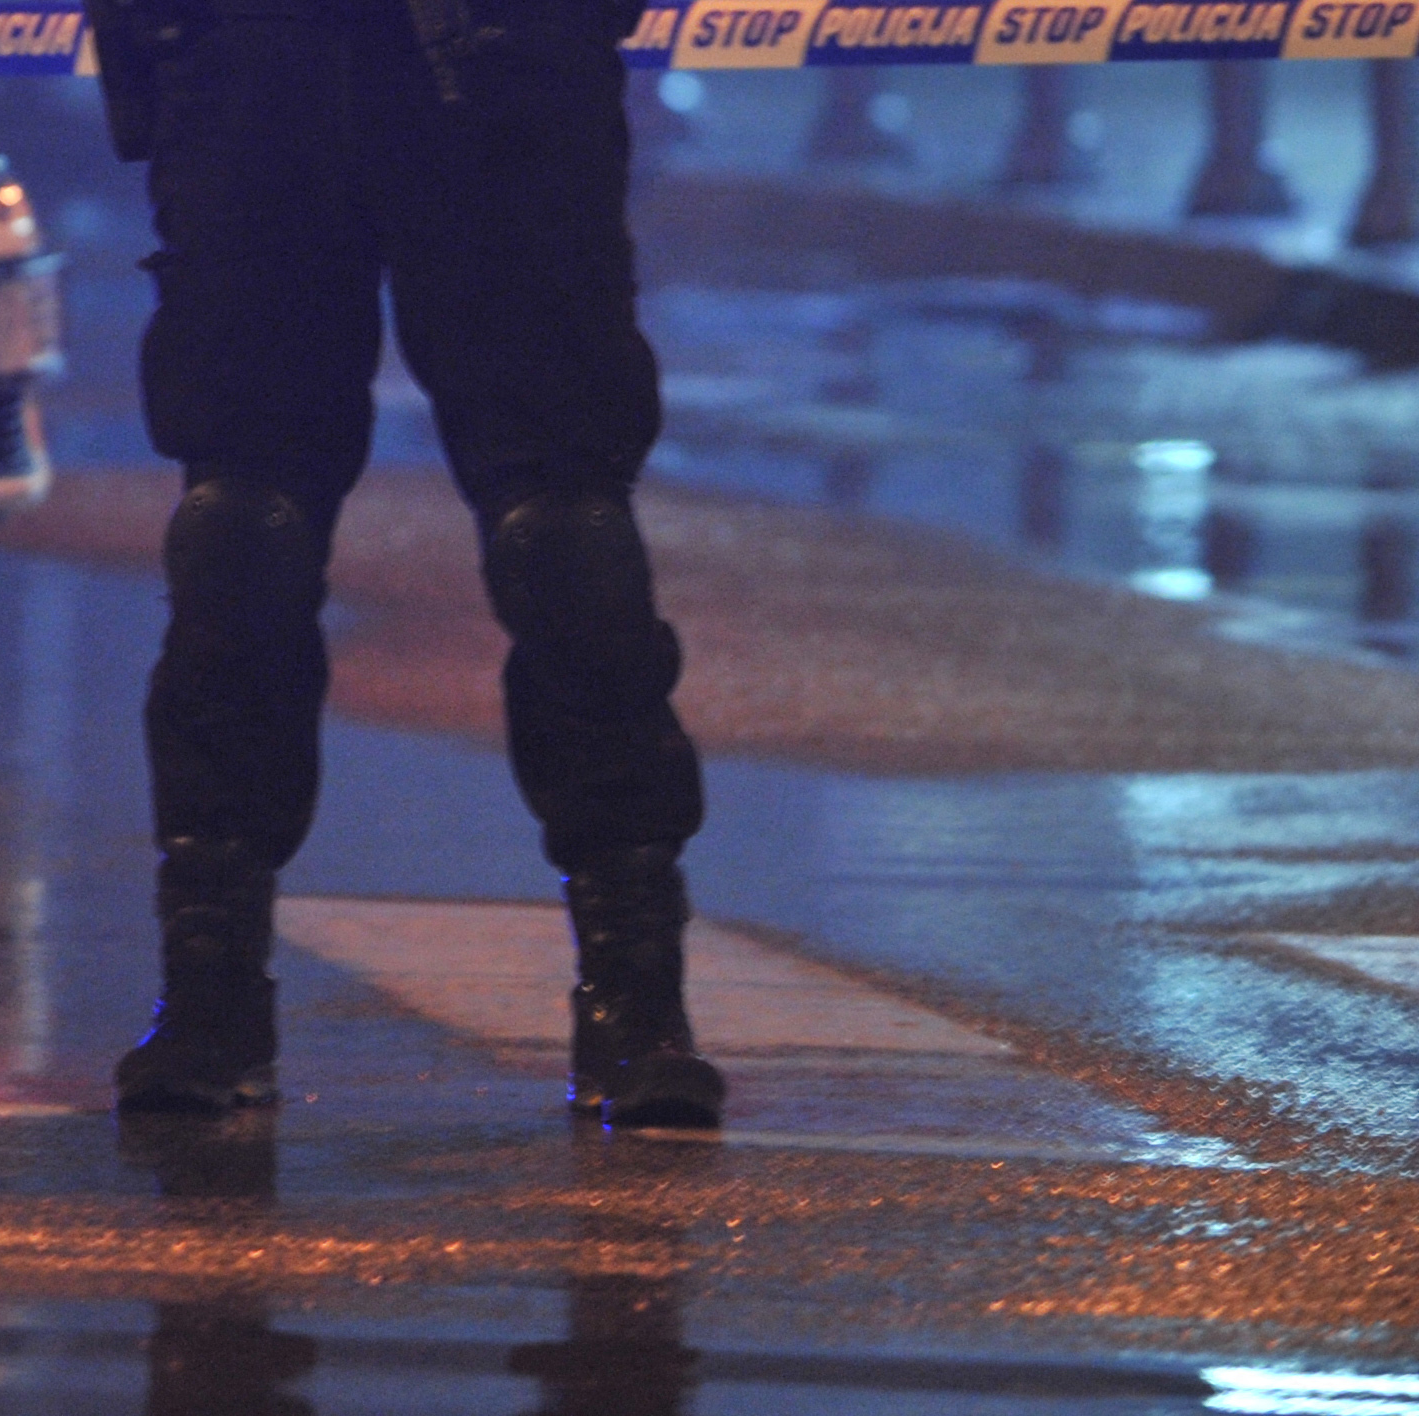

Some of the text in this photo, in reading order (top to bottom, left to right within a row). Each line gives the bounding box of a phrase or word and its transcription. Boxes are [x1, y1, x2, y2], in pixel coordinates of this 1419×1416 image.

[691, 9, 803, 48] STOP
[813, 5, 981, 48] POLICIJA
[995, 5, 1109, 45] STOP
[1118, 2, 1290, 43] POLICIJA
[1303, 1, 1417, 39] STOP
